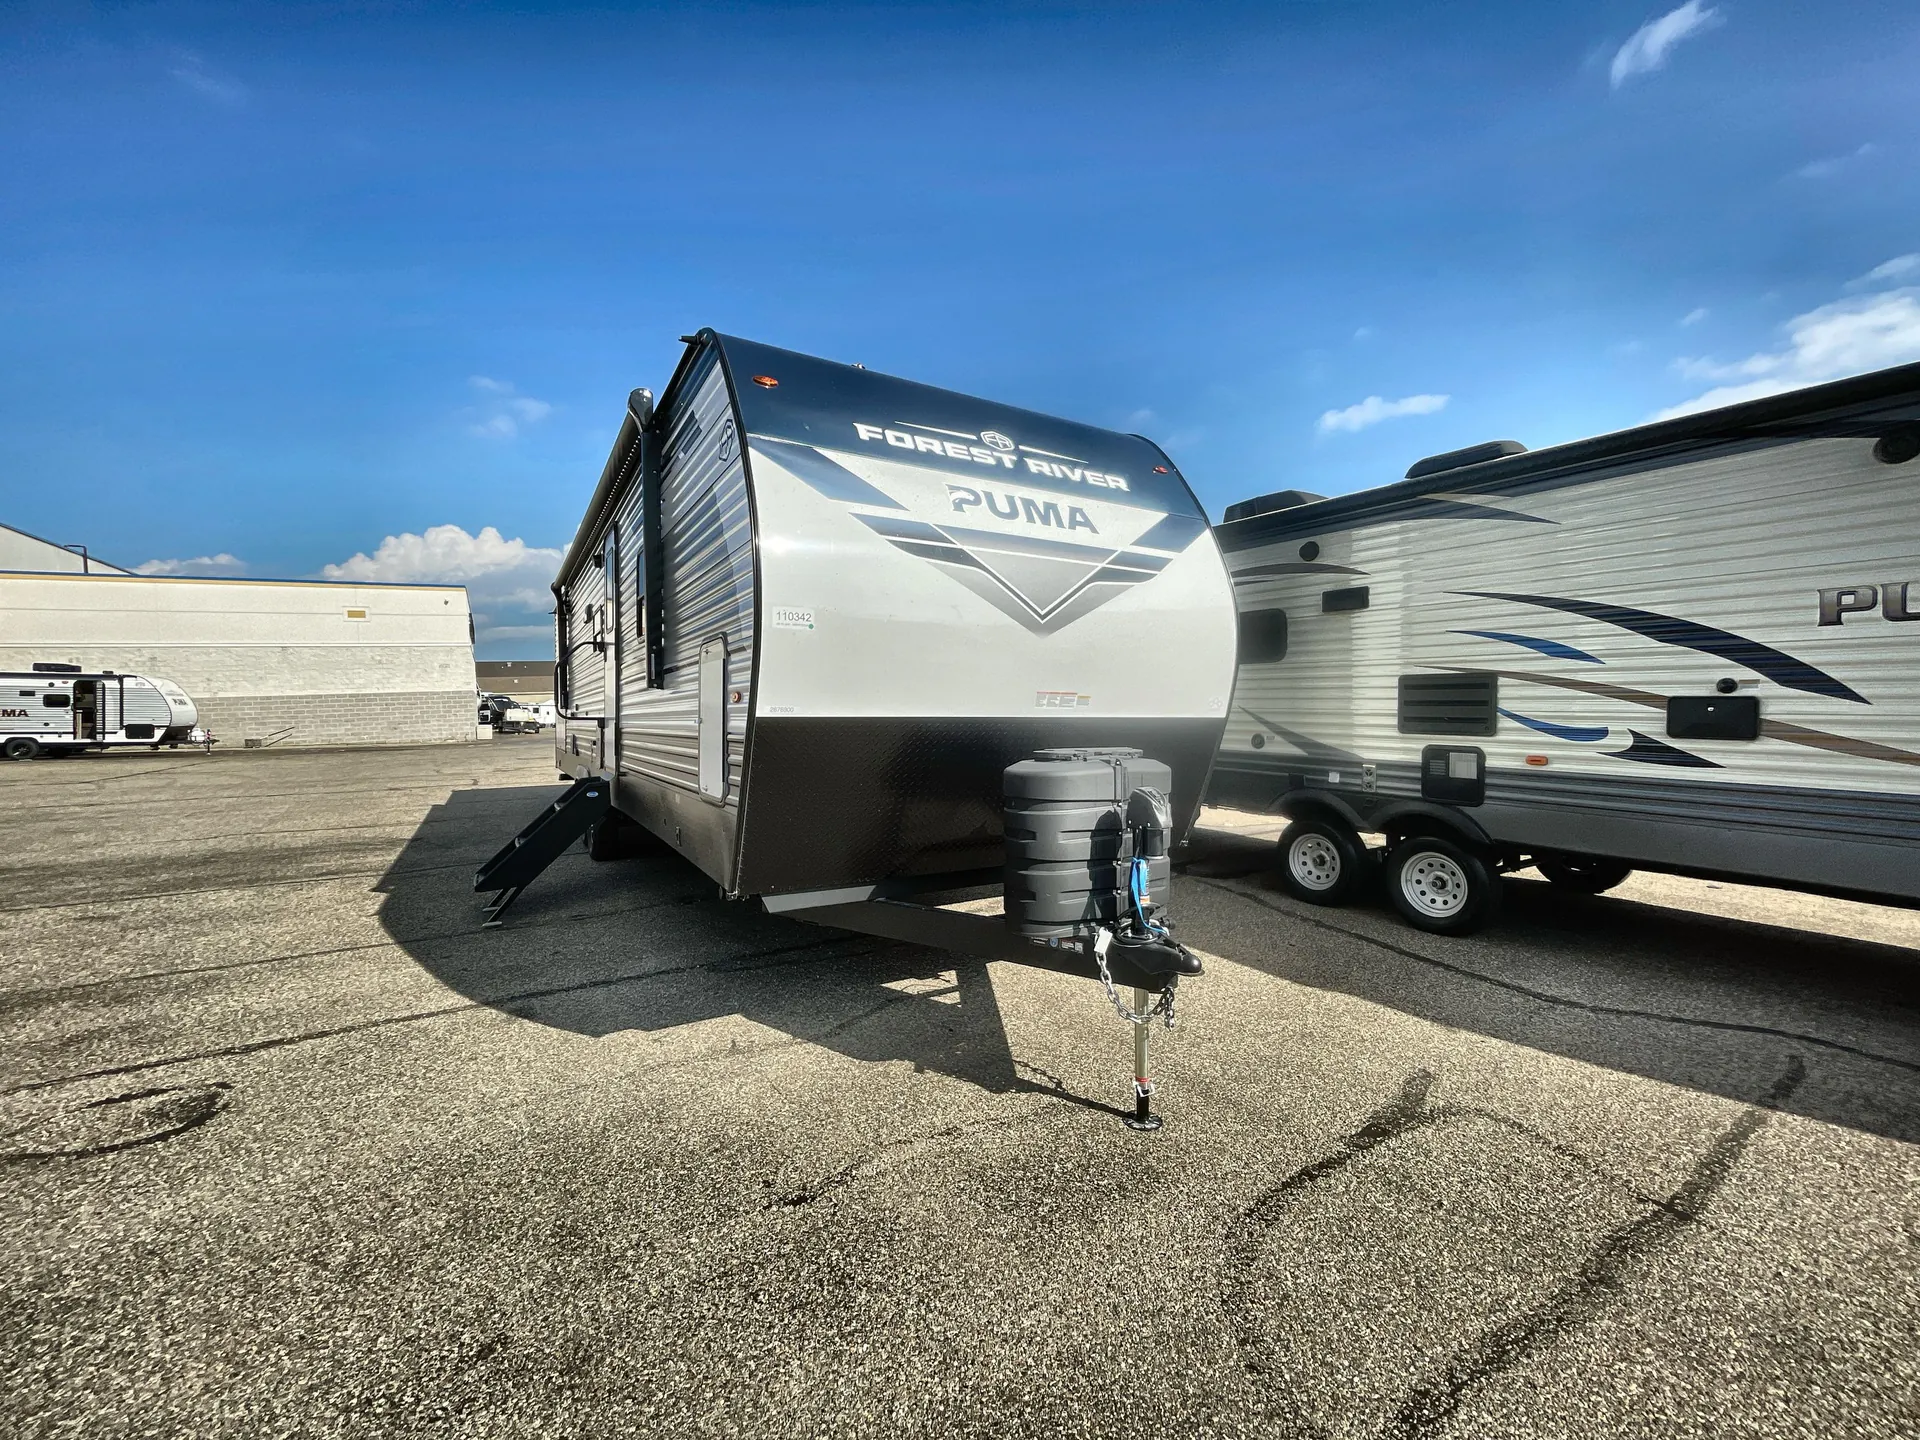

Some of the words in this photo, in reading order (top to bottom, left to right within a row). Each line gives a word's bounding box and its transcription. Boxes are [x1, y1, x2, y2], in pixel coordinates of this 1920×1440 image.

[852, 422, 1017, 469] FOREST
[1023, 457, 1131, 492] RIVER
[944, 483, 1100, 534] PUMA
[776, 611, 812, 622] 110342
